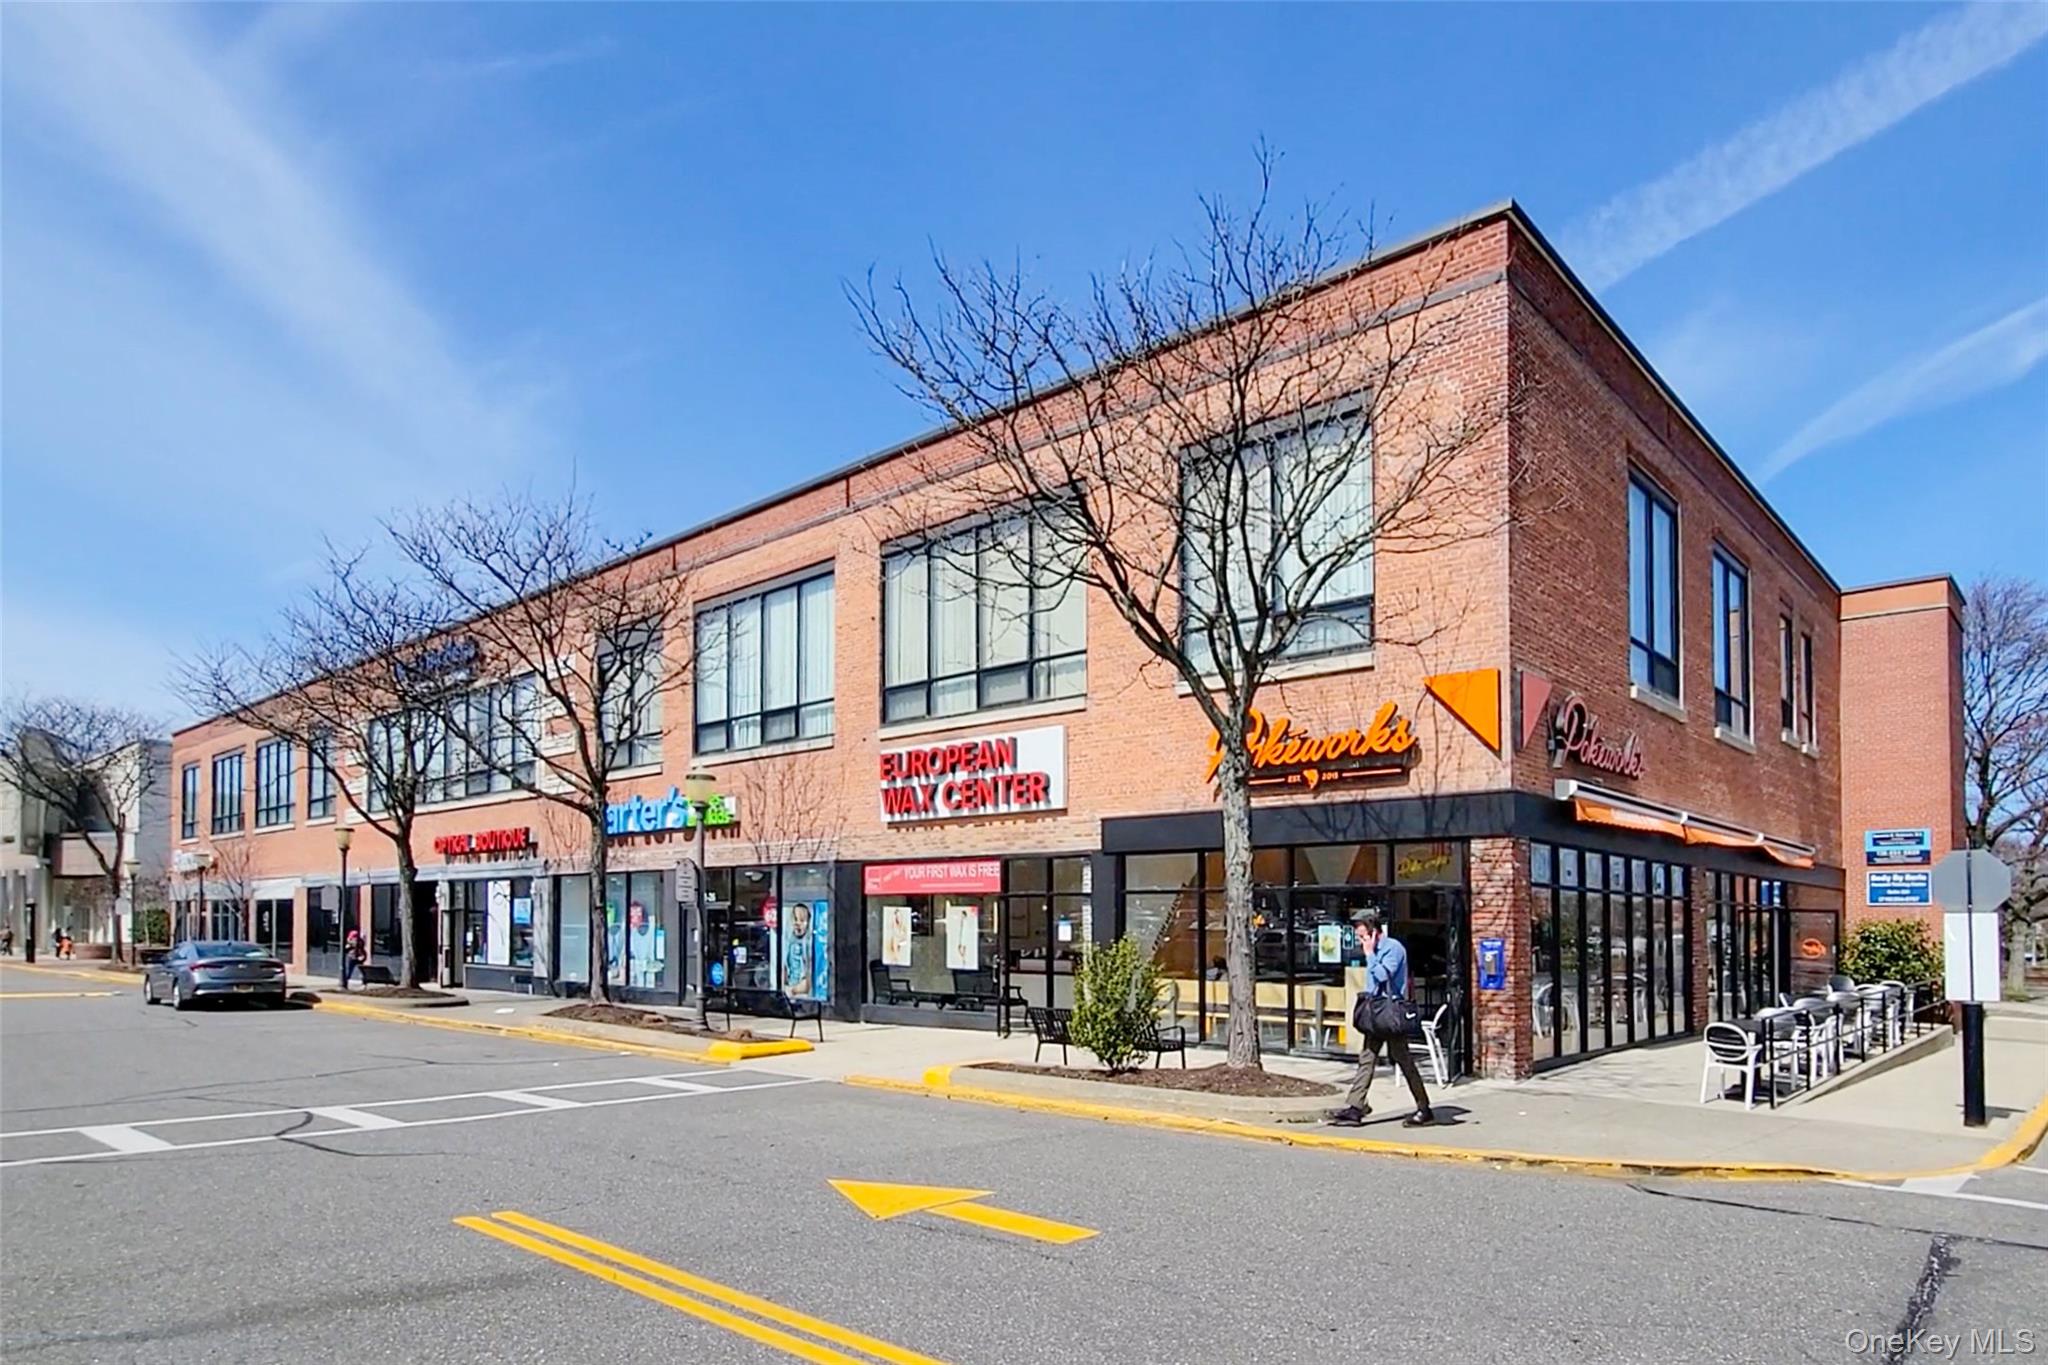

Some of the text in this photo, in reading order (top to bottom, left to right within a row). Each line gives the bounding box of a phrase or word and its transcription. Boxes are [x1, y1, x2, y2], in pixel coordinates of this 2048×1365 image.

[880, 736, 1014, 781] EUROPEAN
[605, 784, 688, 834] arter's
[881, 771, 1049, 815] WAX CENTER
[474, 827, 528, 853] BOUTIQUE
[903, 864, 924, 880] YOUR
[926, 863, 948, 879] FIRST
[949, 862, 968, 878] WAX
[968, 862, 978, 877] IS
[979, 861, 1000, 877] FREE
